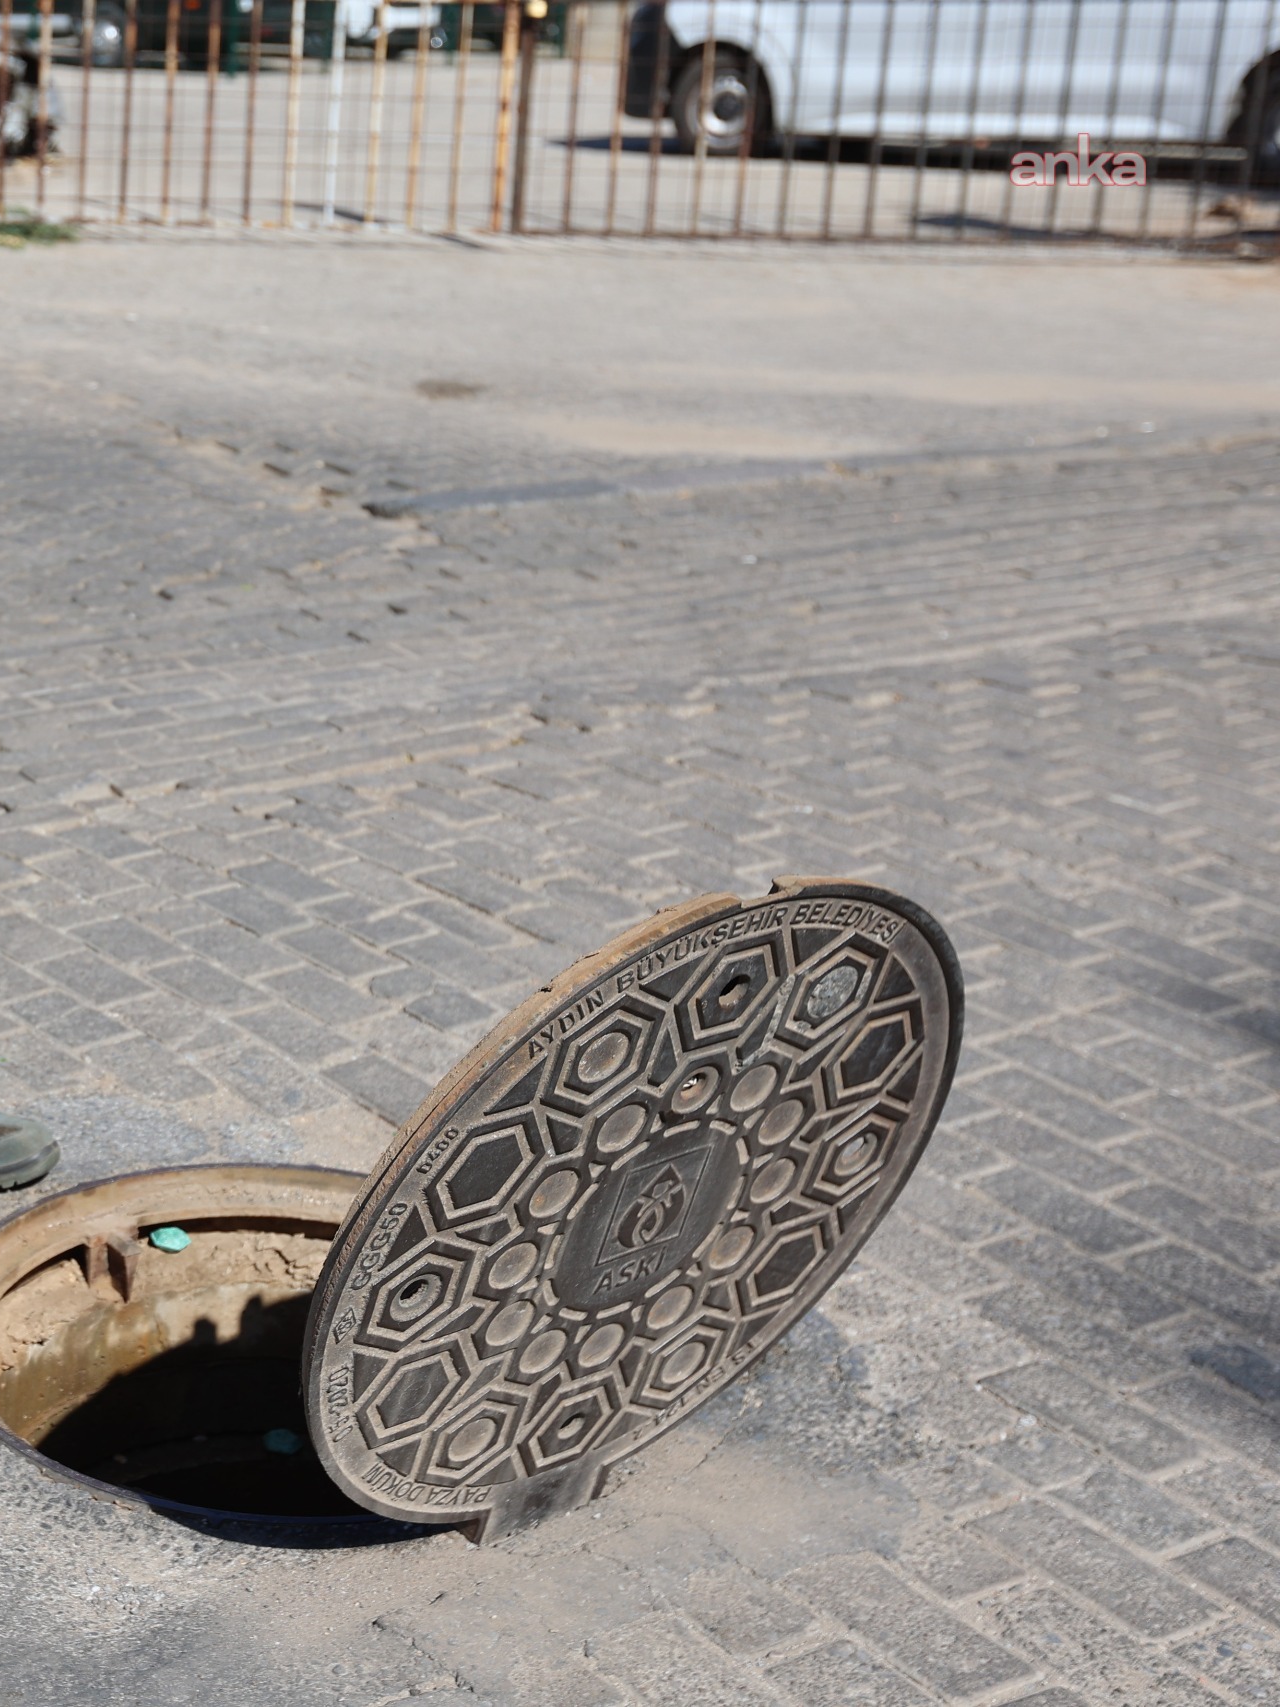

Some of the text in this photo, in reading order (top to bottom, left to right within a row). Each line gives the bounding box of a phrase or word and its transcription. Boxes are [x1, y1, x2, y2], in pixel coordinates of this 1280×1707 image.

[529, 989, 604, 1059] AYDIN
[617, 904, 788, 993] BÜYÜKŞEHİR
[416, 1127, 460, 1174] D400
[350, 1203, 408, 1290] GGG50
[361, 1462, 492, 1506] PAYZA DÖKÜM
